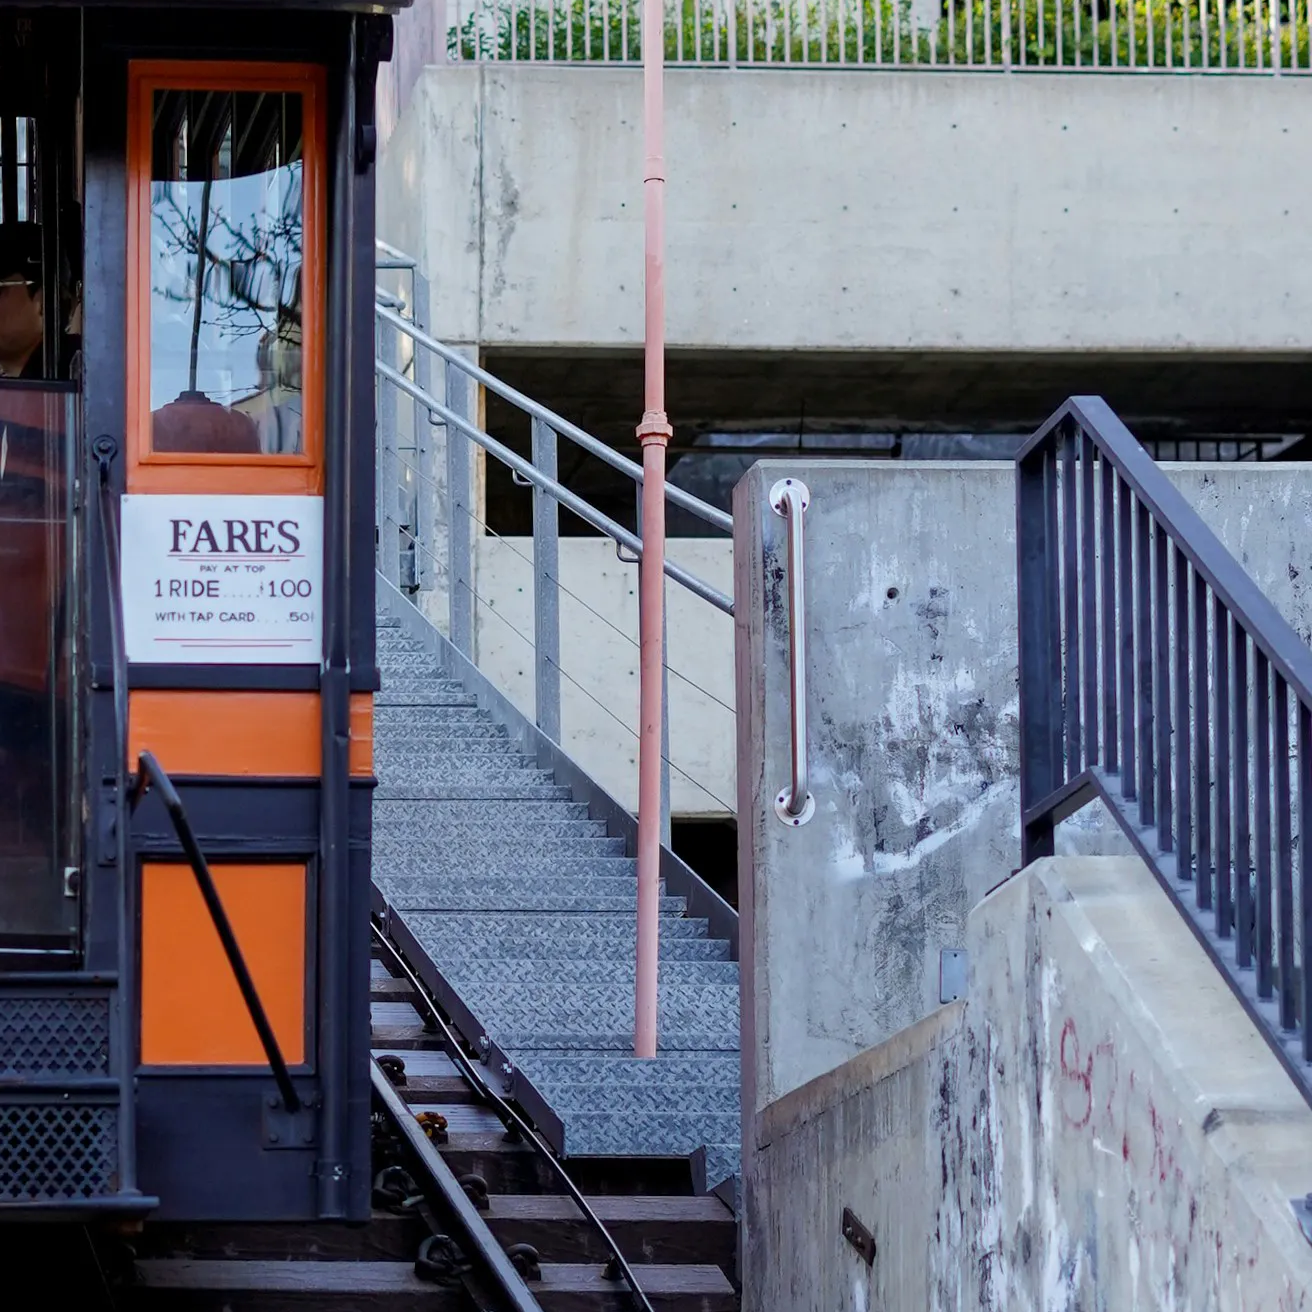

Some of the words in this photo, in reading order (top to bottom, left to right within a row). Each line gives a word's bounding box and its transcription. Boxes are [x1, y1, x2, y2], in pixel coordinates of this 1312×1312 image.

[169, 518, 301, 554] FARES
[199, 565, 218, 573] PAY
[224, 565, 240, 573] AT
[244, 565, 266, 573] TOP
[154, 579, 163, 598] 1
[169, 579, 220, 598] RIDE
[155, 612, 186, 622] WITH
[189, 612, 214, 622] TAP
[219, 612, 256, 622] CARD
